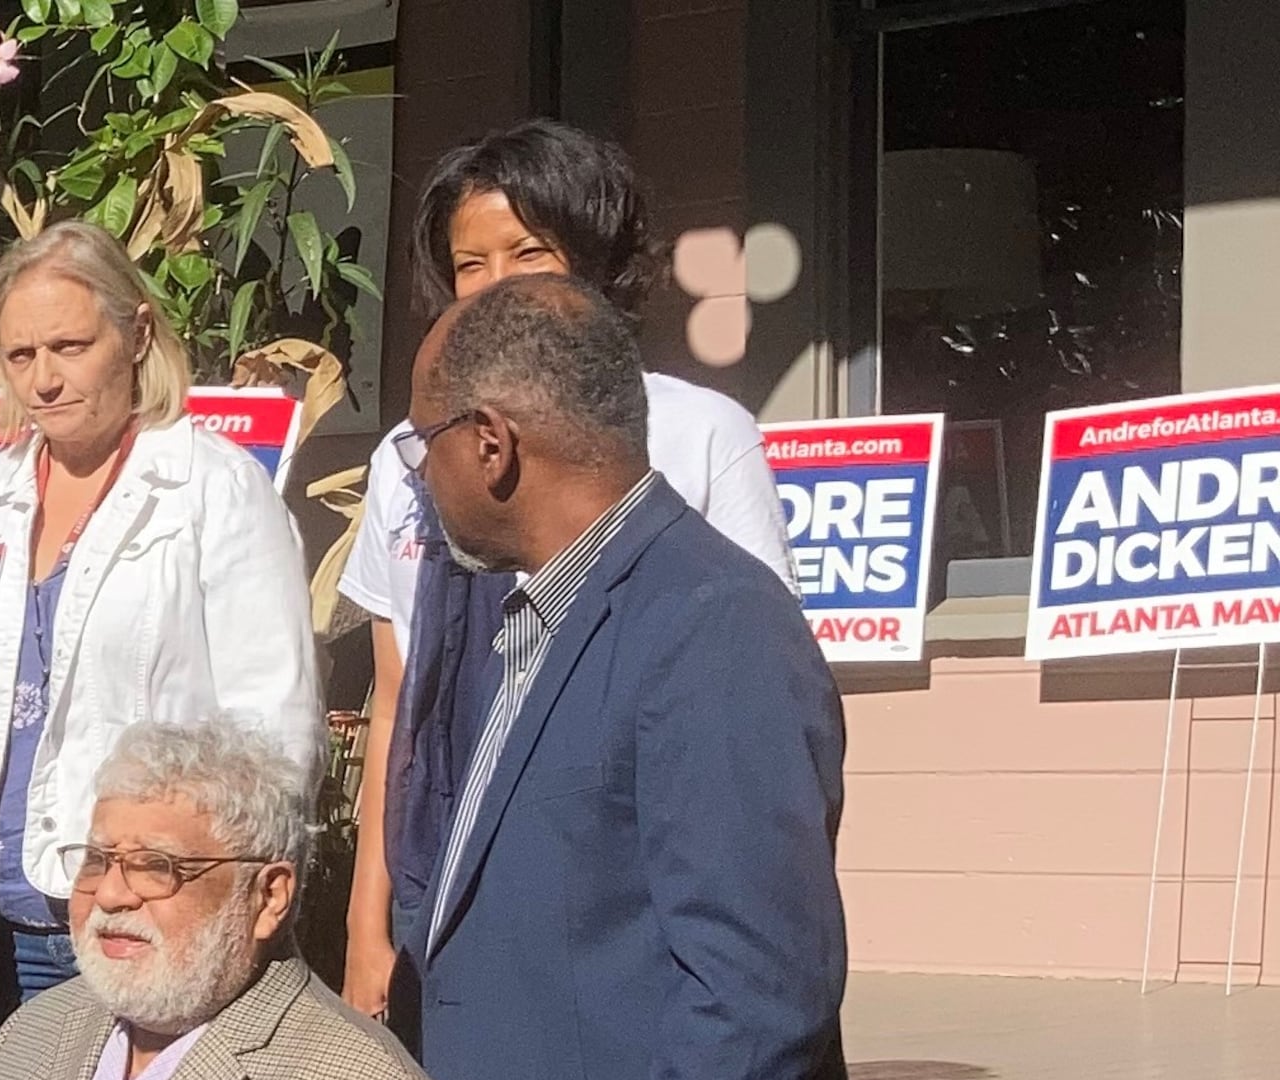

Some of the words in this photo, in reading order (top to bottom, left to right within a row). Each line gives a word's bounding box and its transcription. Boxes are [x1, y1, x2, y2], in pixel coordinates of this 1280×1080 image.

[765, 438, 902, 460] Atlanta.com
[810, 617, 901, 643] AYOR
[1047, 603, 1203, 641] ATLANTA
